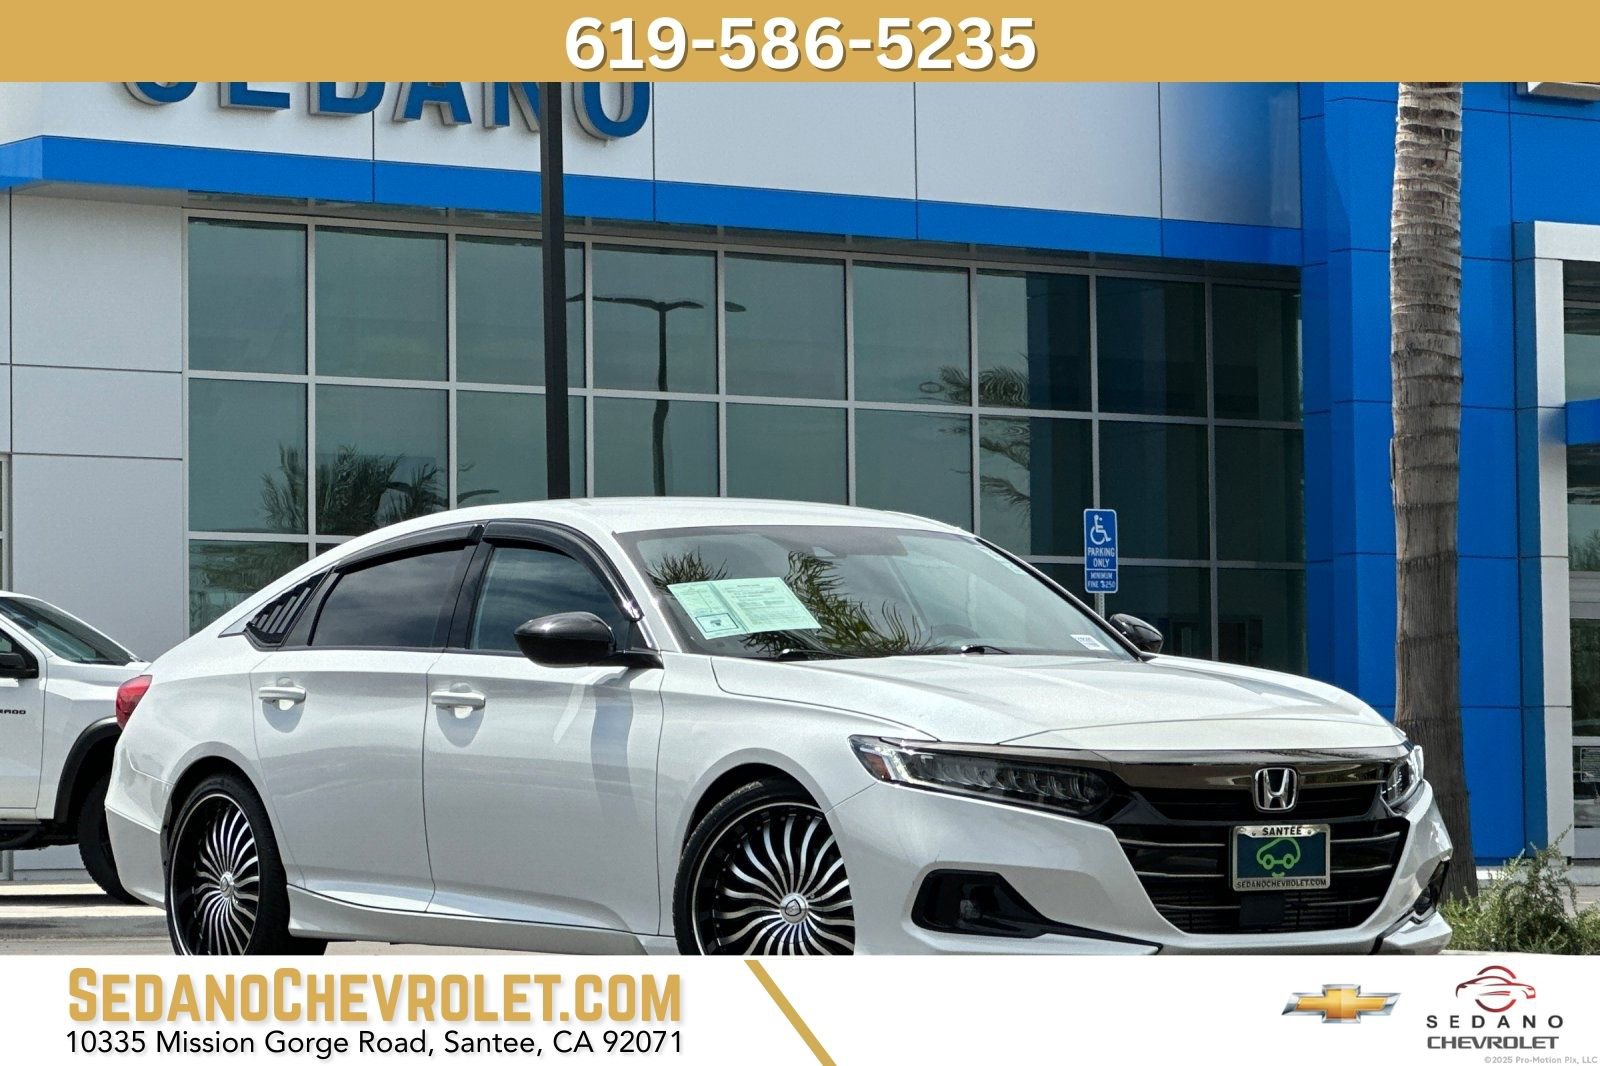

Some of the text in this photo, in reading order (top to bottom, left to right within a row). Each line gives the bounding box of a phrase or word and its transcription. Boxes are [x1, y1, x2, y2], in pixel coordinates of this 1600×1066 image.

[1087, 547, 1115, 557] PARKING
[1092, 558, 1110, 568] ONLY
[1088, 580, 1099, 588] FINE
[1262, 826, 1303, 836] SANTEE
[1236, 878, 1327, 889] SEDANOCHEVROLET.COM
